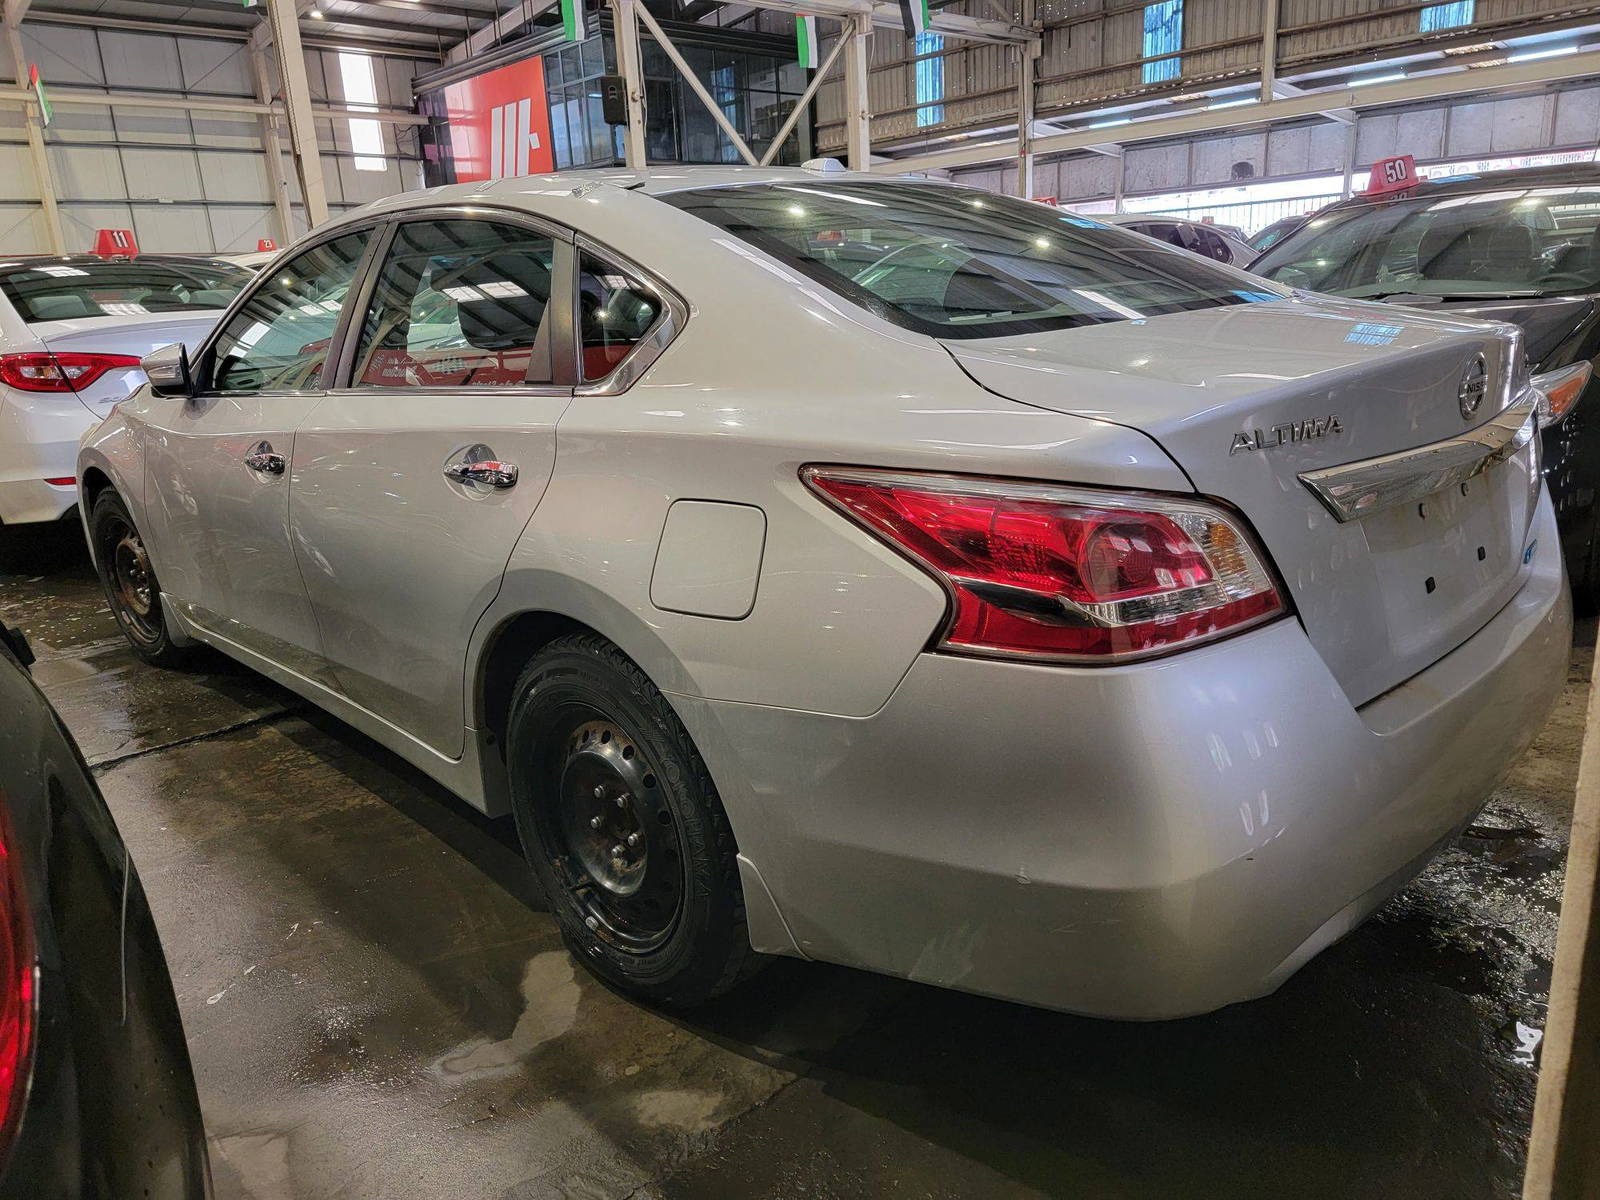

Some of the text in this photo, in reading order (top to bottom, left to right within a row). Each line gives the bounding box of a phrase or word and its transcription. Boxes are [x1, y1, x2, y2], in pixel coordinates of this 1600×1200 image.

[1384, 159, 1408, 183] 50
[111, 231, 129, 248] 11
[1229, 414, 1344, 457] ALTIMA
